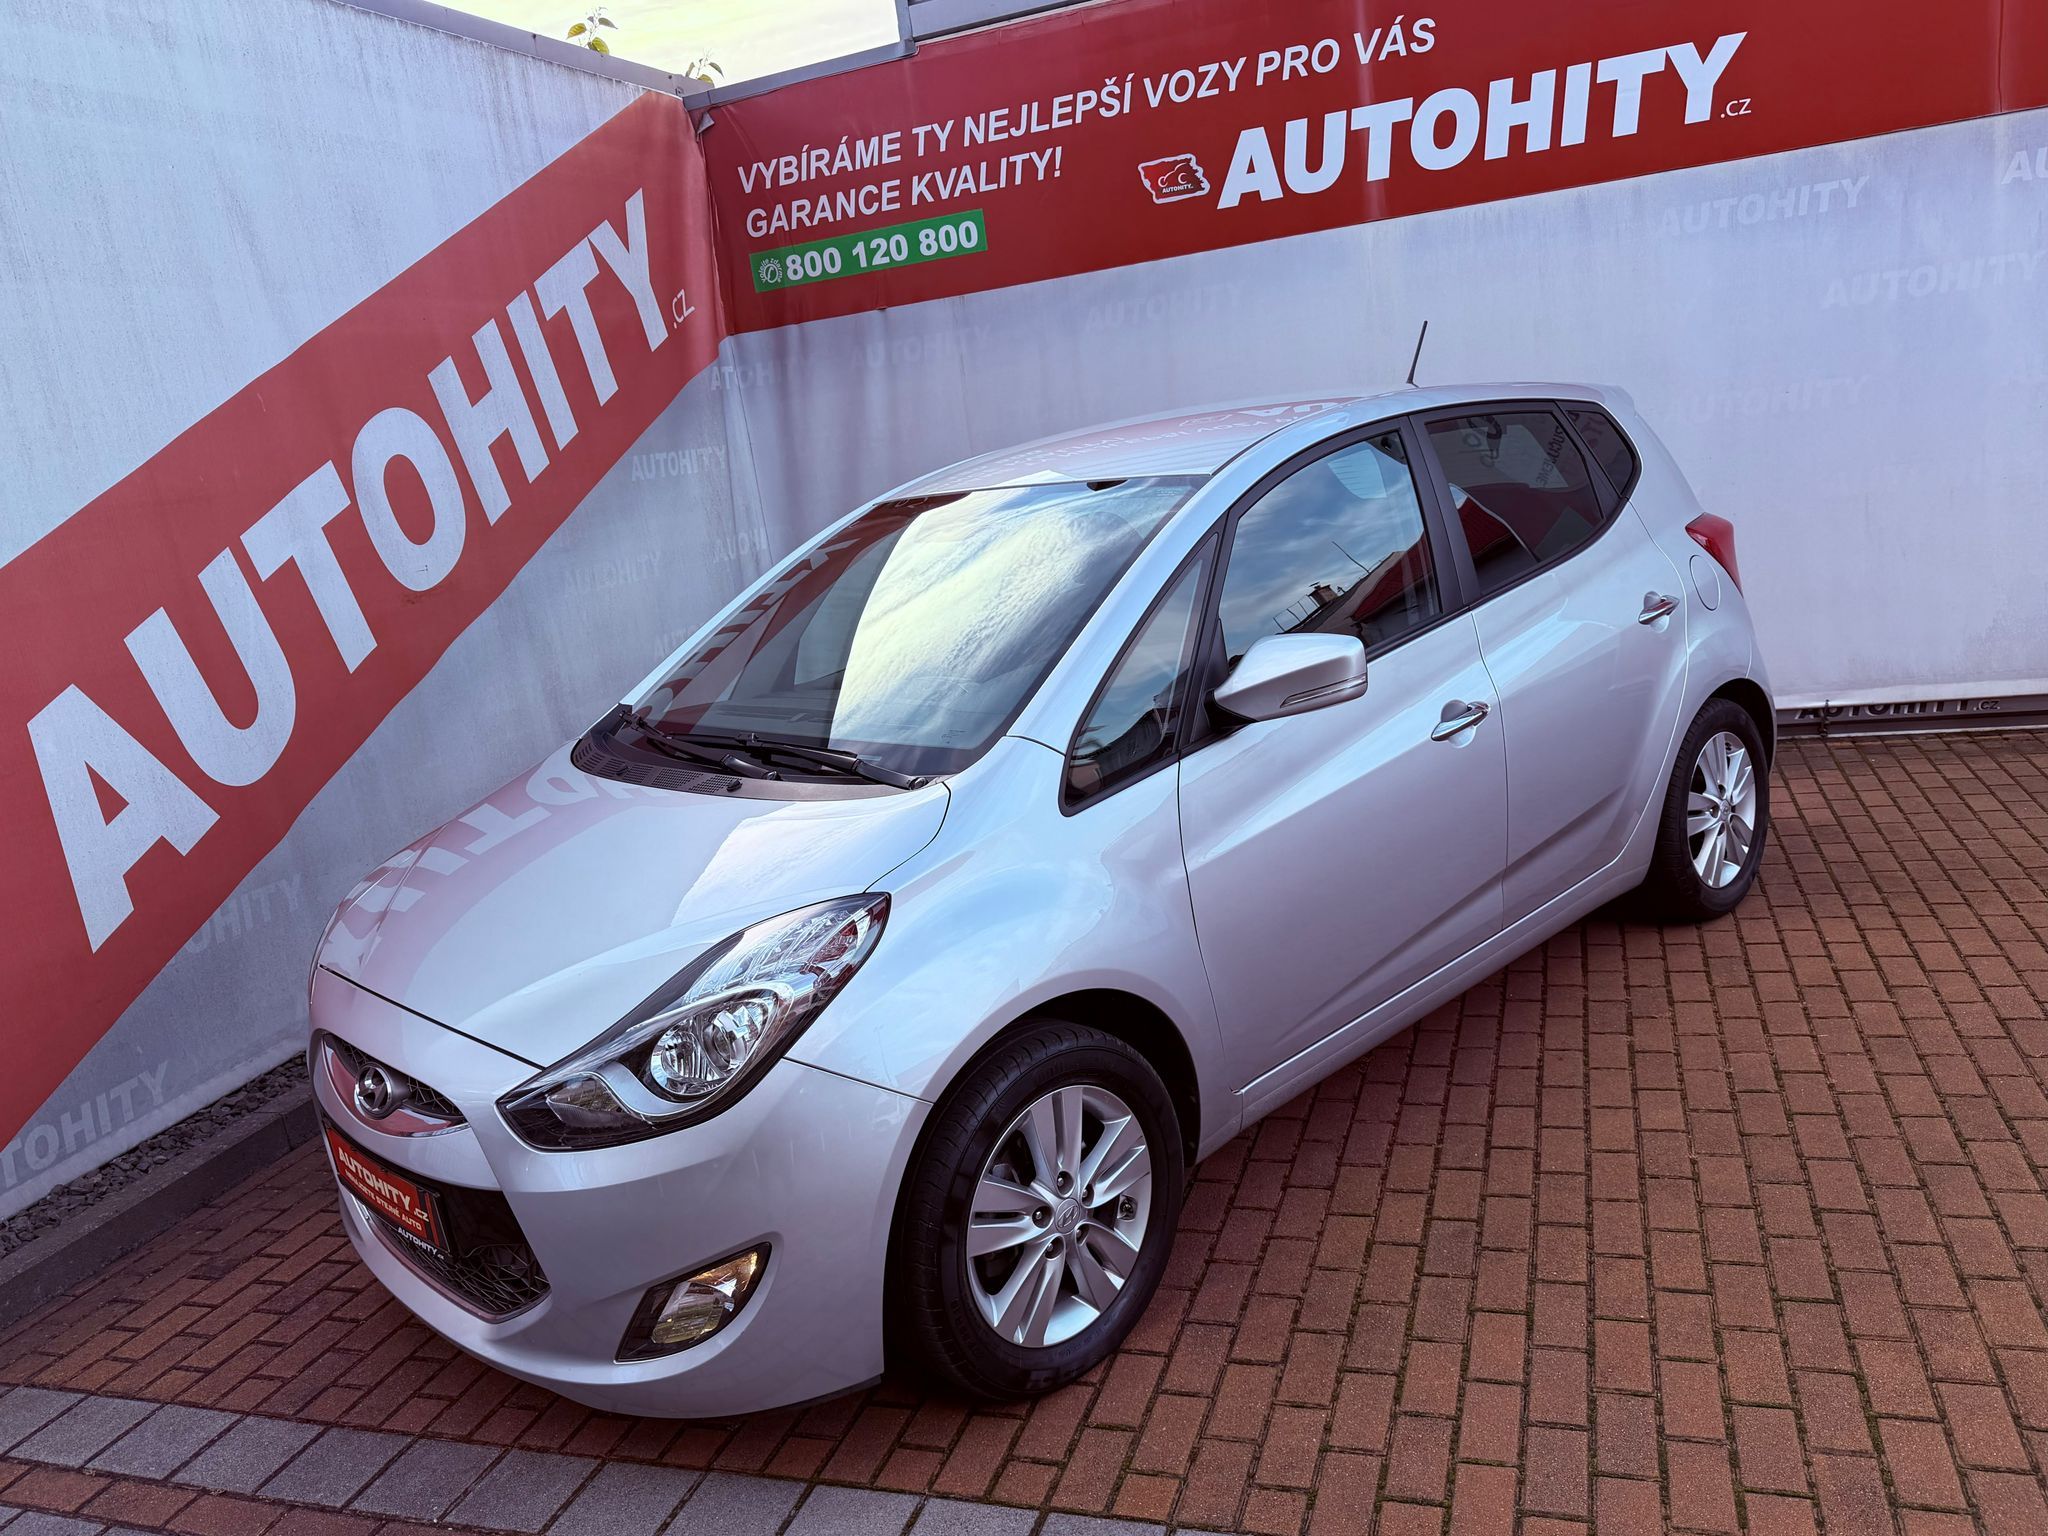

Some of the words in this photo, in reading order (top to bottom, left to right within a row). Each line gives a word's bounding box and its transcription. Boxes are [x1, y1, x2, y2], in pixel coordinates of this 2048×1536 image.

[737, 131, 902, 194] VYBÍRÁME
[911, 119, 954, 157] TY
[963, 72, 1136, 147] NEJLEPŠÍ
[1142, 56, 1248, 109] VOZY
[1256, 38, 1341, 87] PRO
[1353, 14, 1436, 65] VÁS
[745, 179, 901, 239] GARANCE
[911, 145, 1063, 206] KVALITY!
[785, 246, 842, 281] 800
[852, 234, 908, 268] 120
[918, 221, 979, 256] 800
[26, 187, 669, 954] AUTOHITY
[338, 1147, 411, 1212] AUTOHITY
[397, 1226, 438, 1256] AUTOHITY
